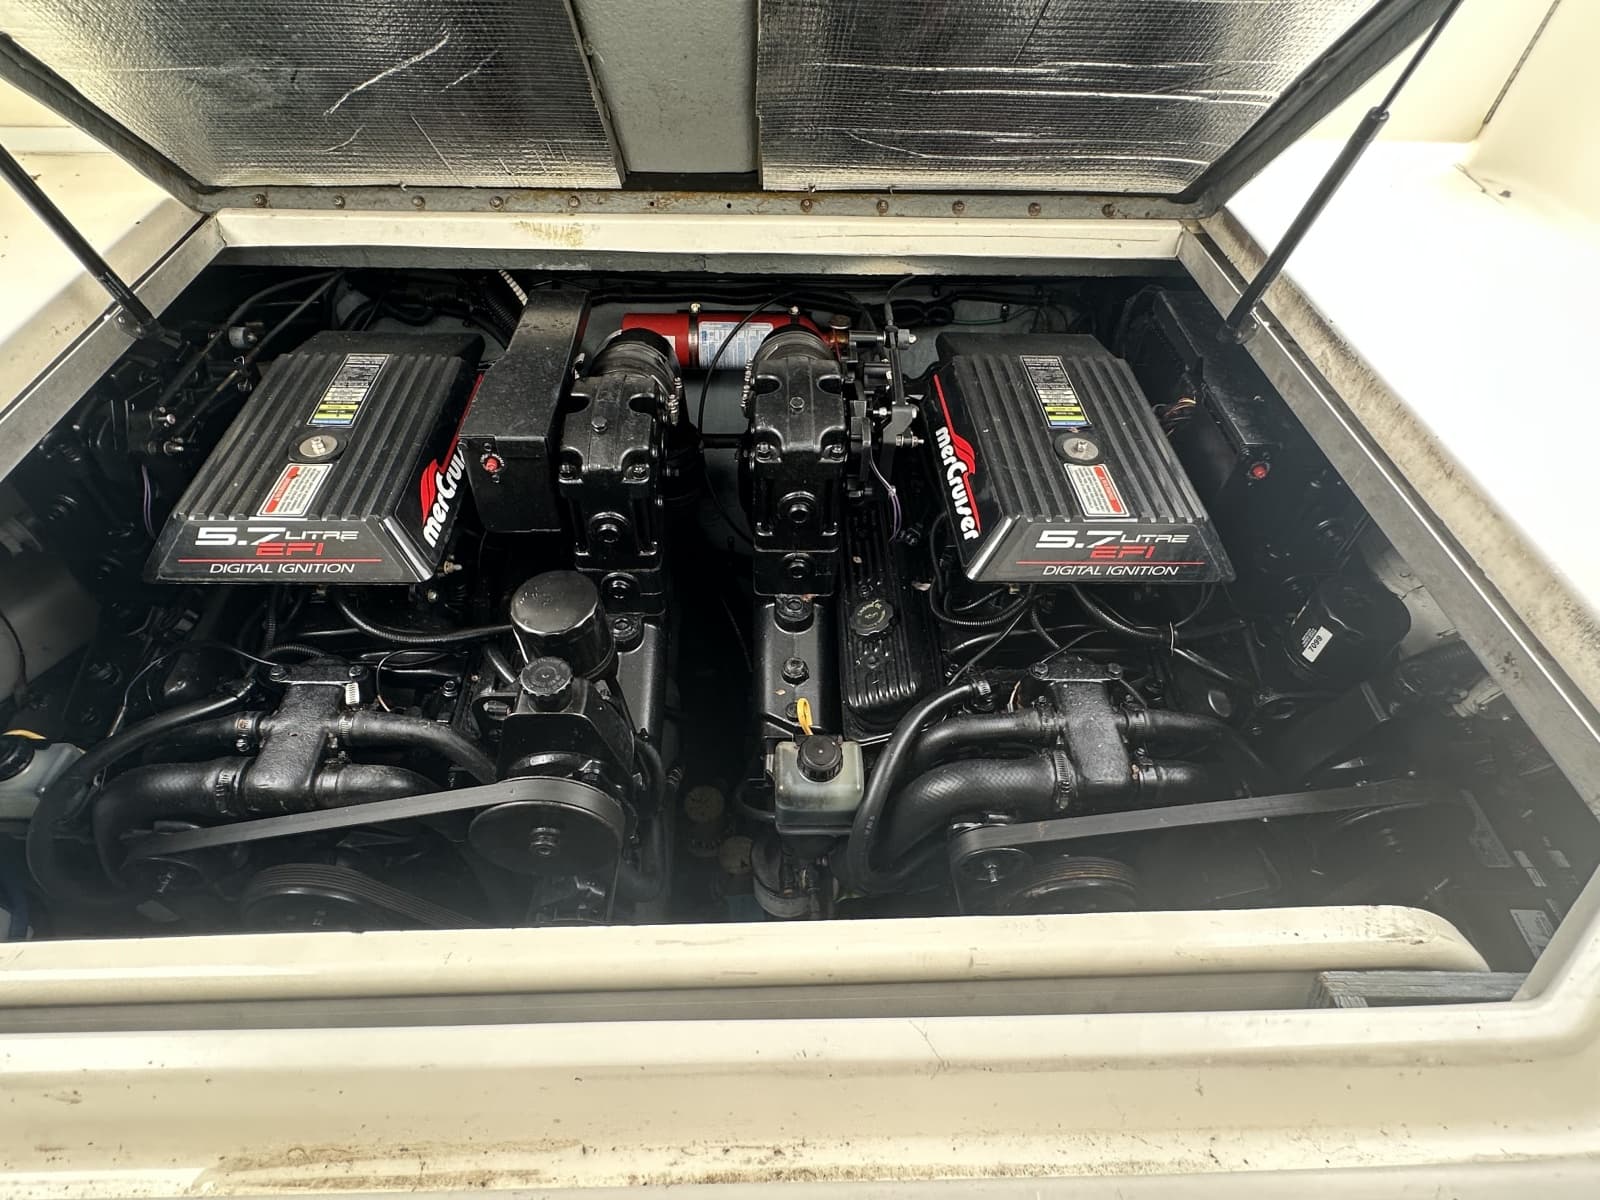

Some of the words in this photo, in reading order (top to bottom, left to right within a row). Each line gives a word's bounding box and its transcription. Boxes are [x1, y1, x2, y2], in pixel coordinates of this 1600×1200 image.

[195, 527, 286, 546] 5.7
[284, 531, 360, 542] LITRE
[1035, 530, 1125, 549] 5.7
[1120, 534, 1191, 544] LITRE
[256, 543, 324, 556] EFI
[1089, 546, 1156, 559] EFI
[209, 563, 274, 574] DIGITAL
[277, 563, 355, 574] IGNITION
[1042, 565, 1103, 576] DIGITAL
[1105, 565, 1179, 576] IGNITION
[1308, 634, 1323, 652] 7099
